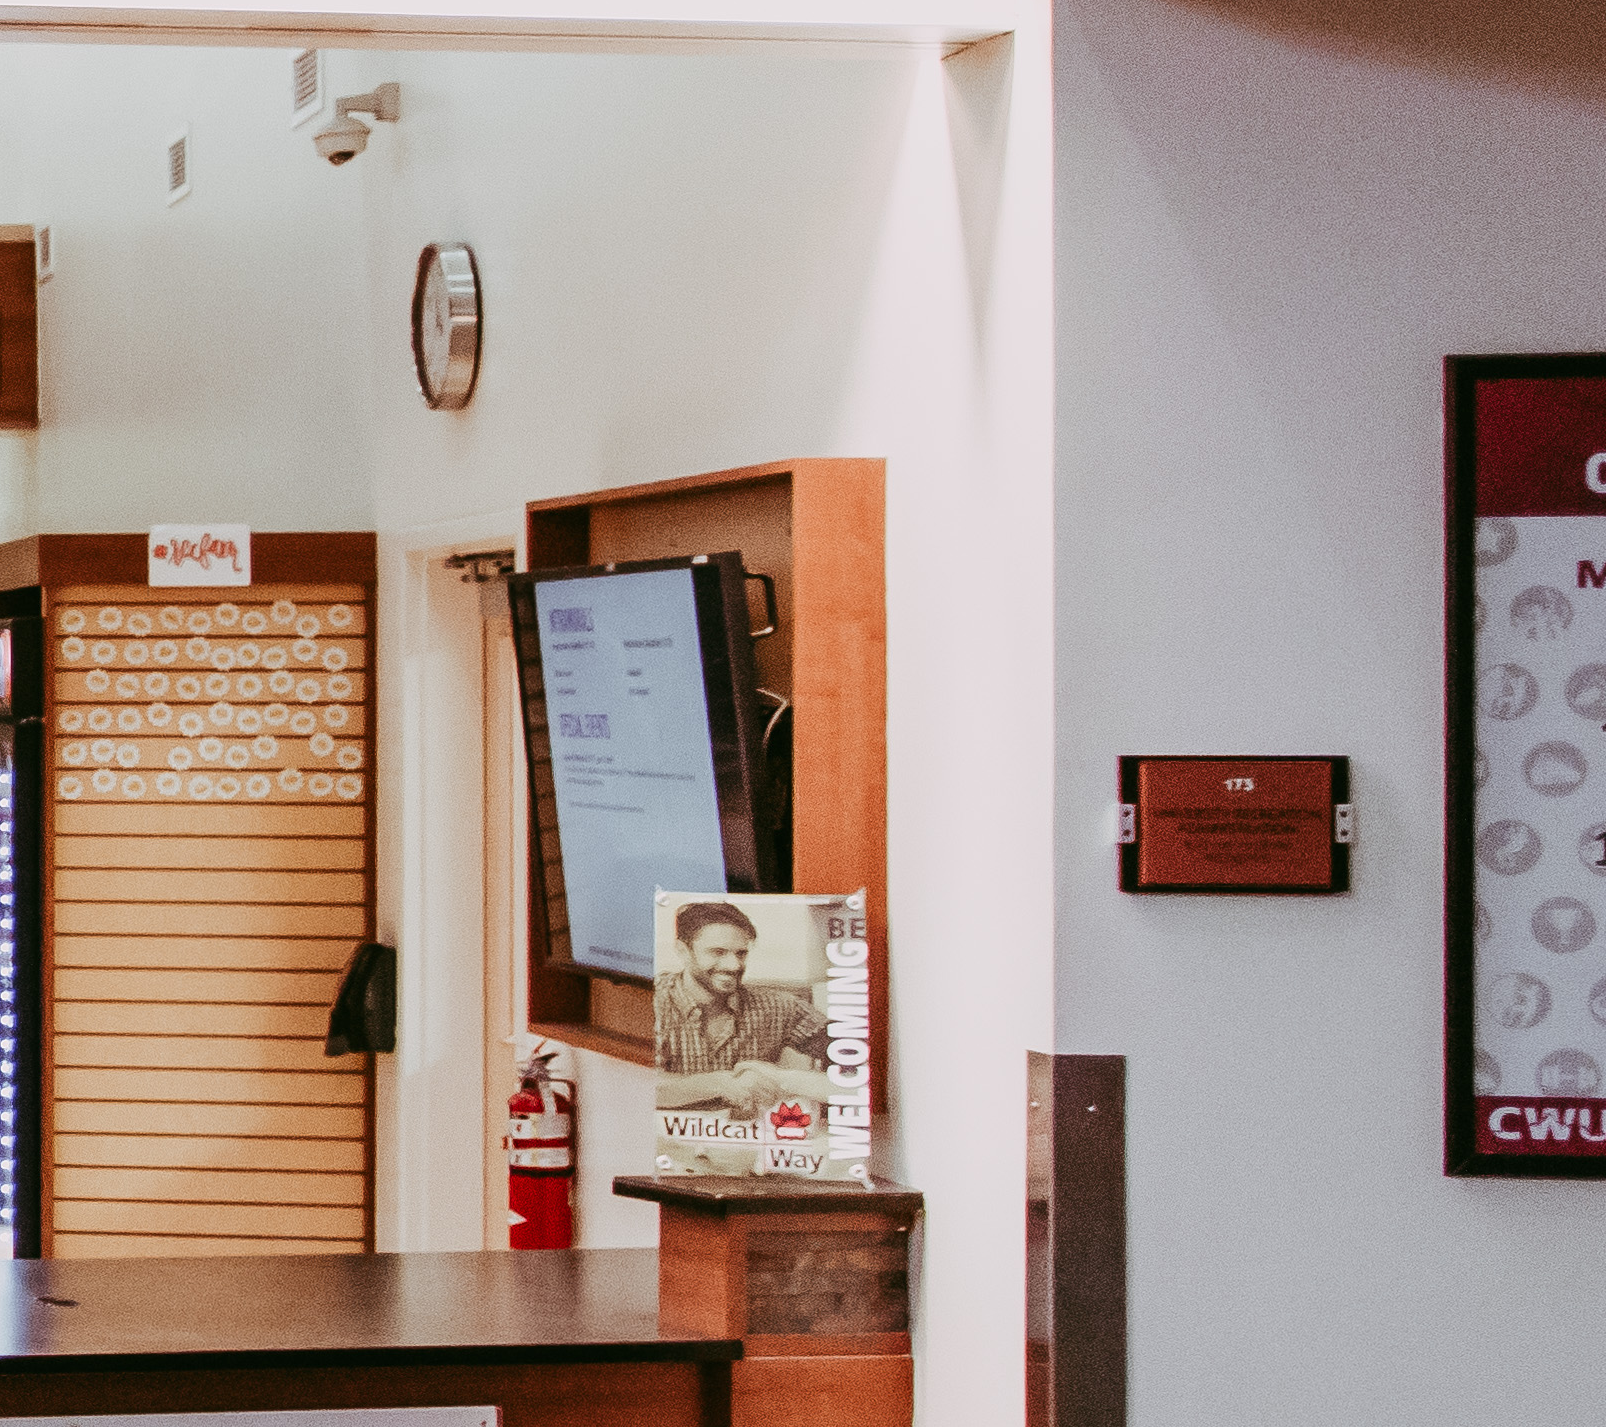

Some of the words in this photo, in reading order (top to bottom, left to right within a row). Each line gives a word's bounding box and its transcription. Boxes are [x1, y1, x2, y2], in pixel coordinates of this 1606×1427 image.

[829, 918, 866, 940] BE
[827, 942, 870, 1160] WELCOMING
[664, 1117, 760, 1140] Wildcat
[769, 1148, 823, 1175] Way
